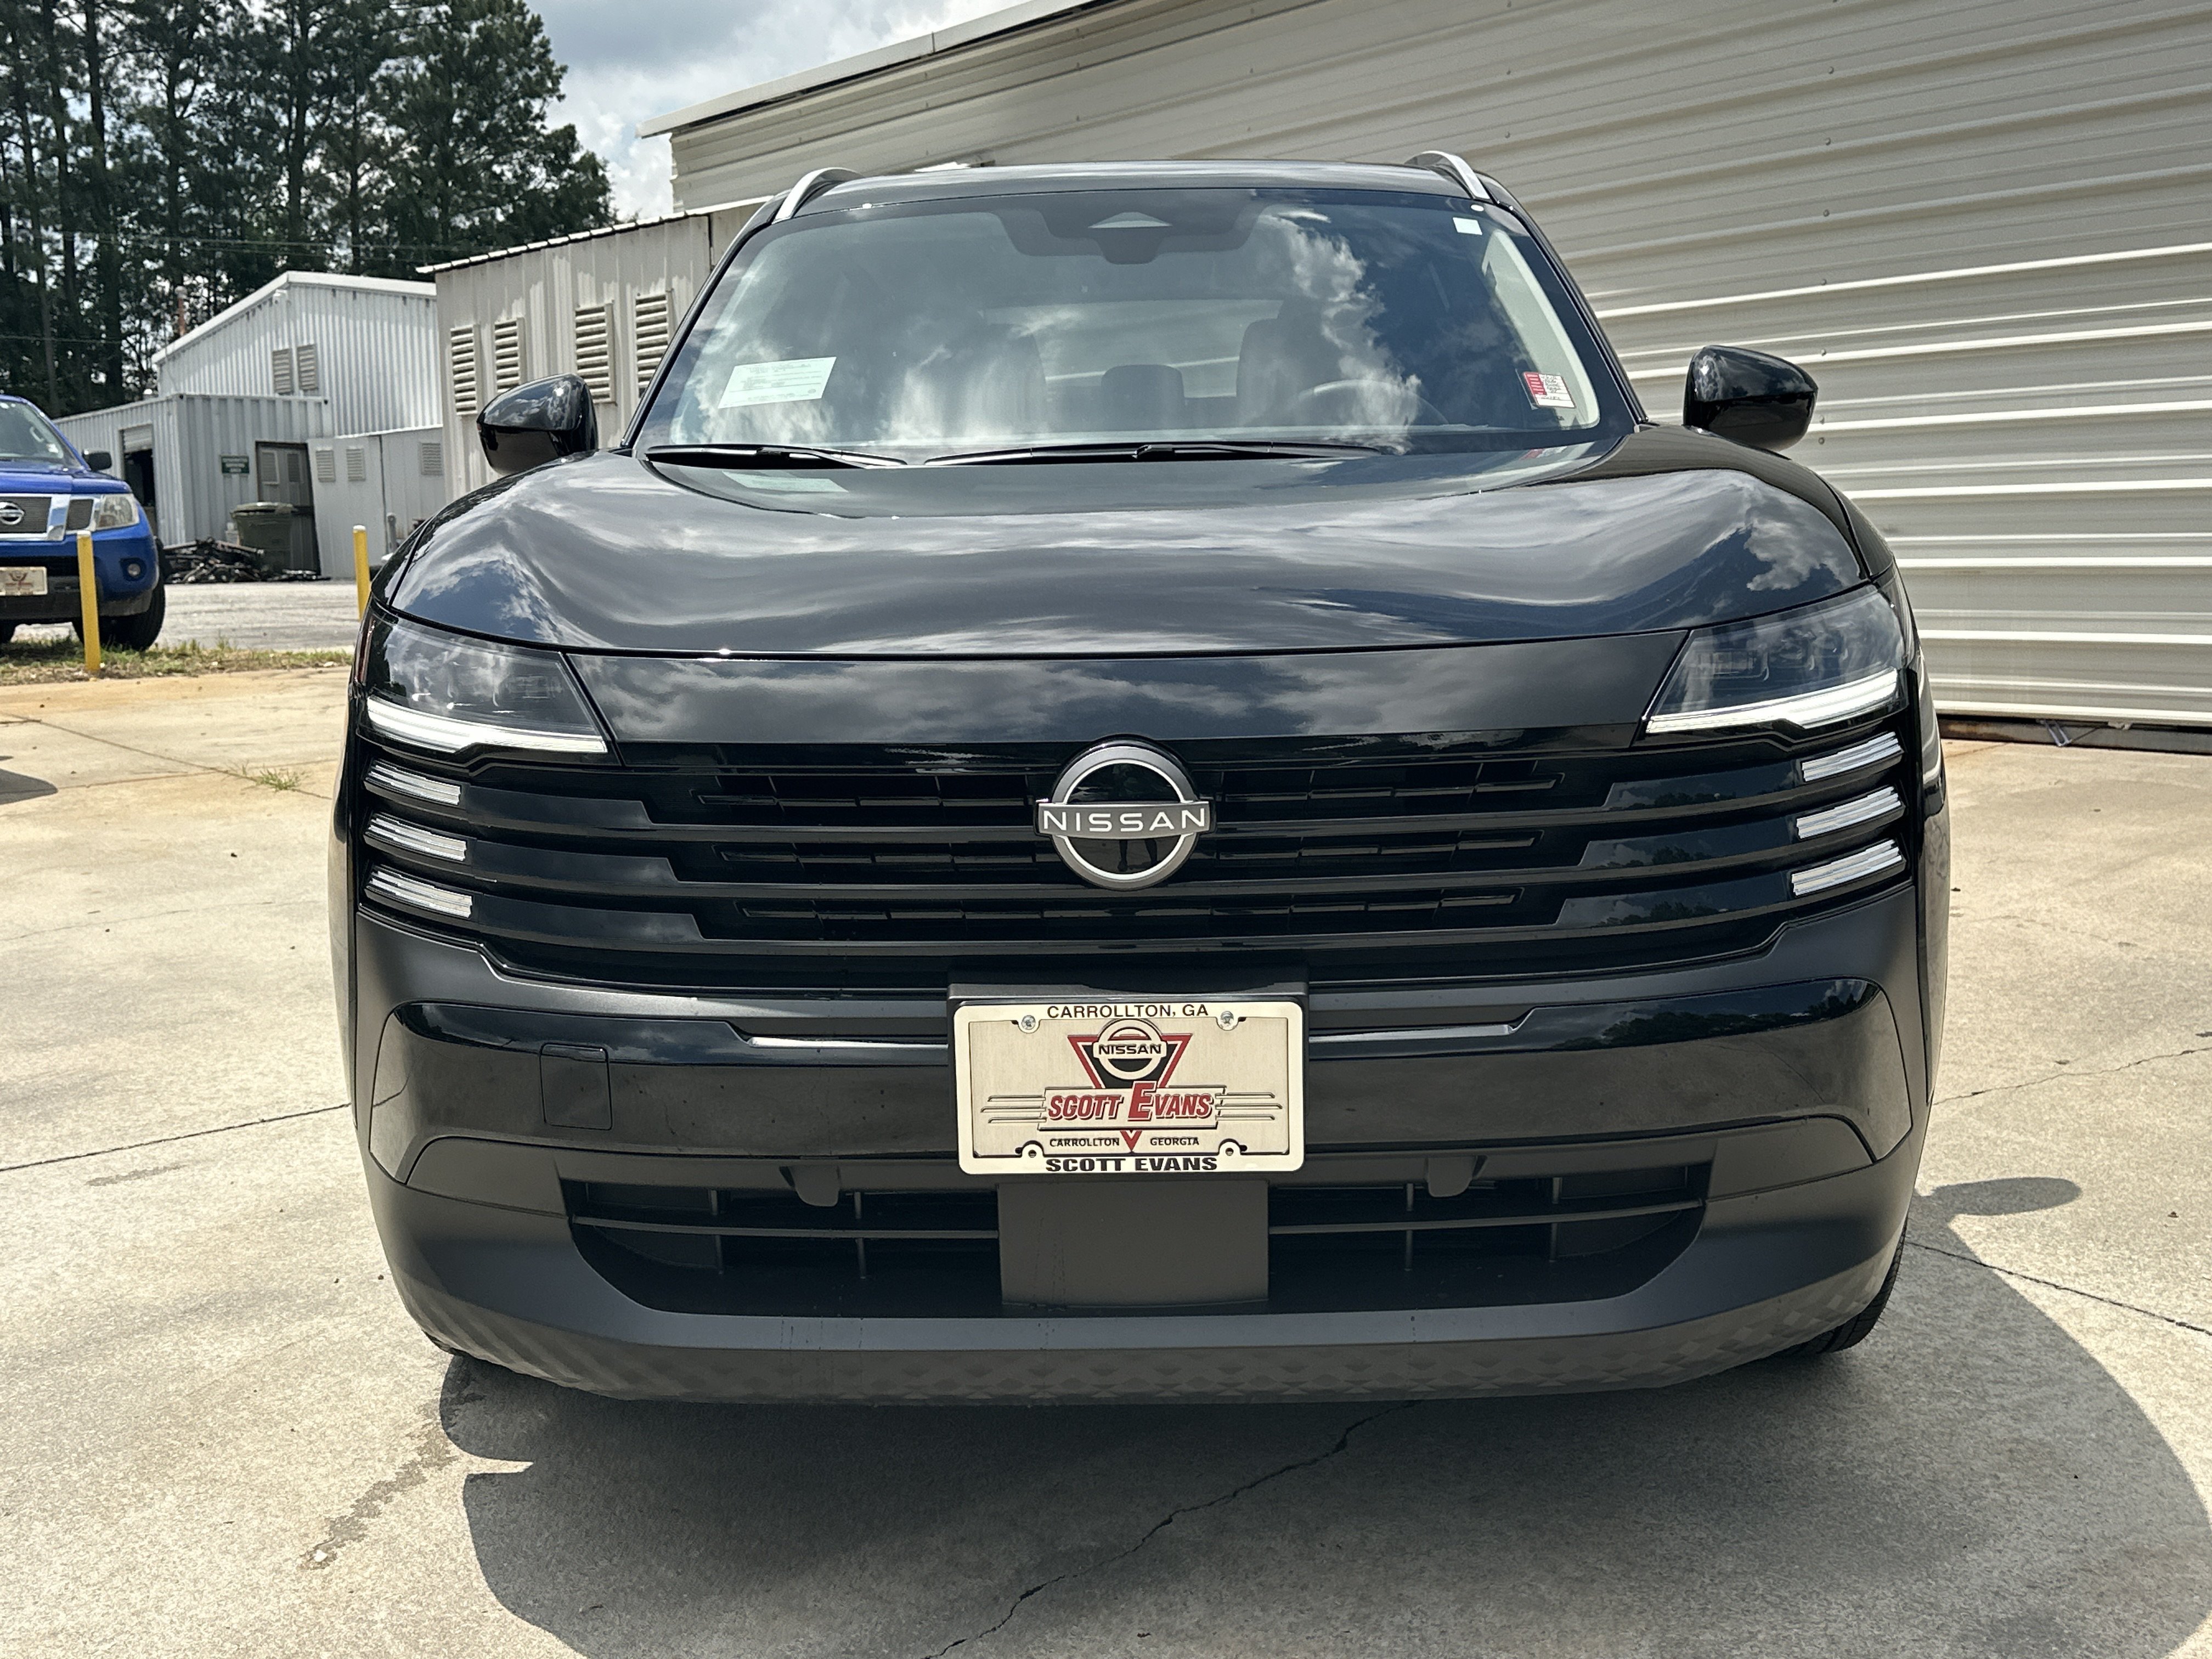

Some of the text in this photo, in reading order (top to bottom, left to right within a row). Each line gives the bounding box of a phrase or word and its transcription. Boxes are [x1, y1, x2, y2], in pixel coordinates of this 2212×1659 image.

[1043, 808, 1205, 832] NISSAN
[1047, 1003, 1208, 1018] CARROLLTON, GA
[1098, 1043, 1161, 1055] NISSAN
[1048, 1081, 1214, 1121] SCOTT EVANS
[1049, 1137, 1199, 1147] CARROLLTON GEORGIA
[1046, 1157, 1217, 1171] SCOTT EVANS
